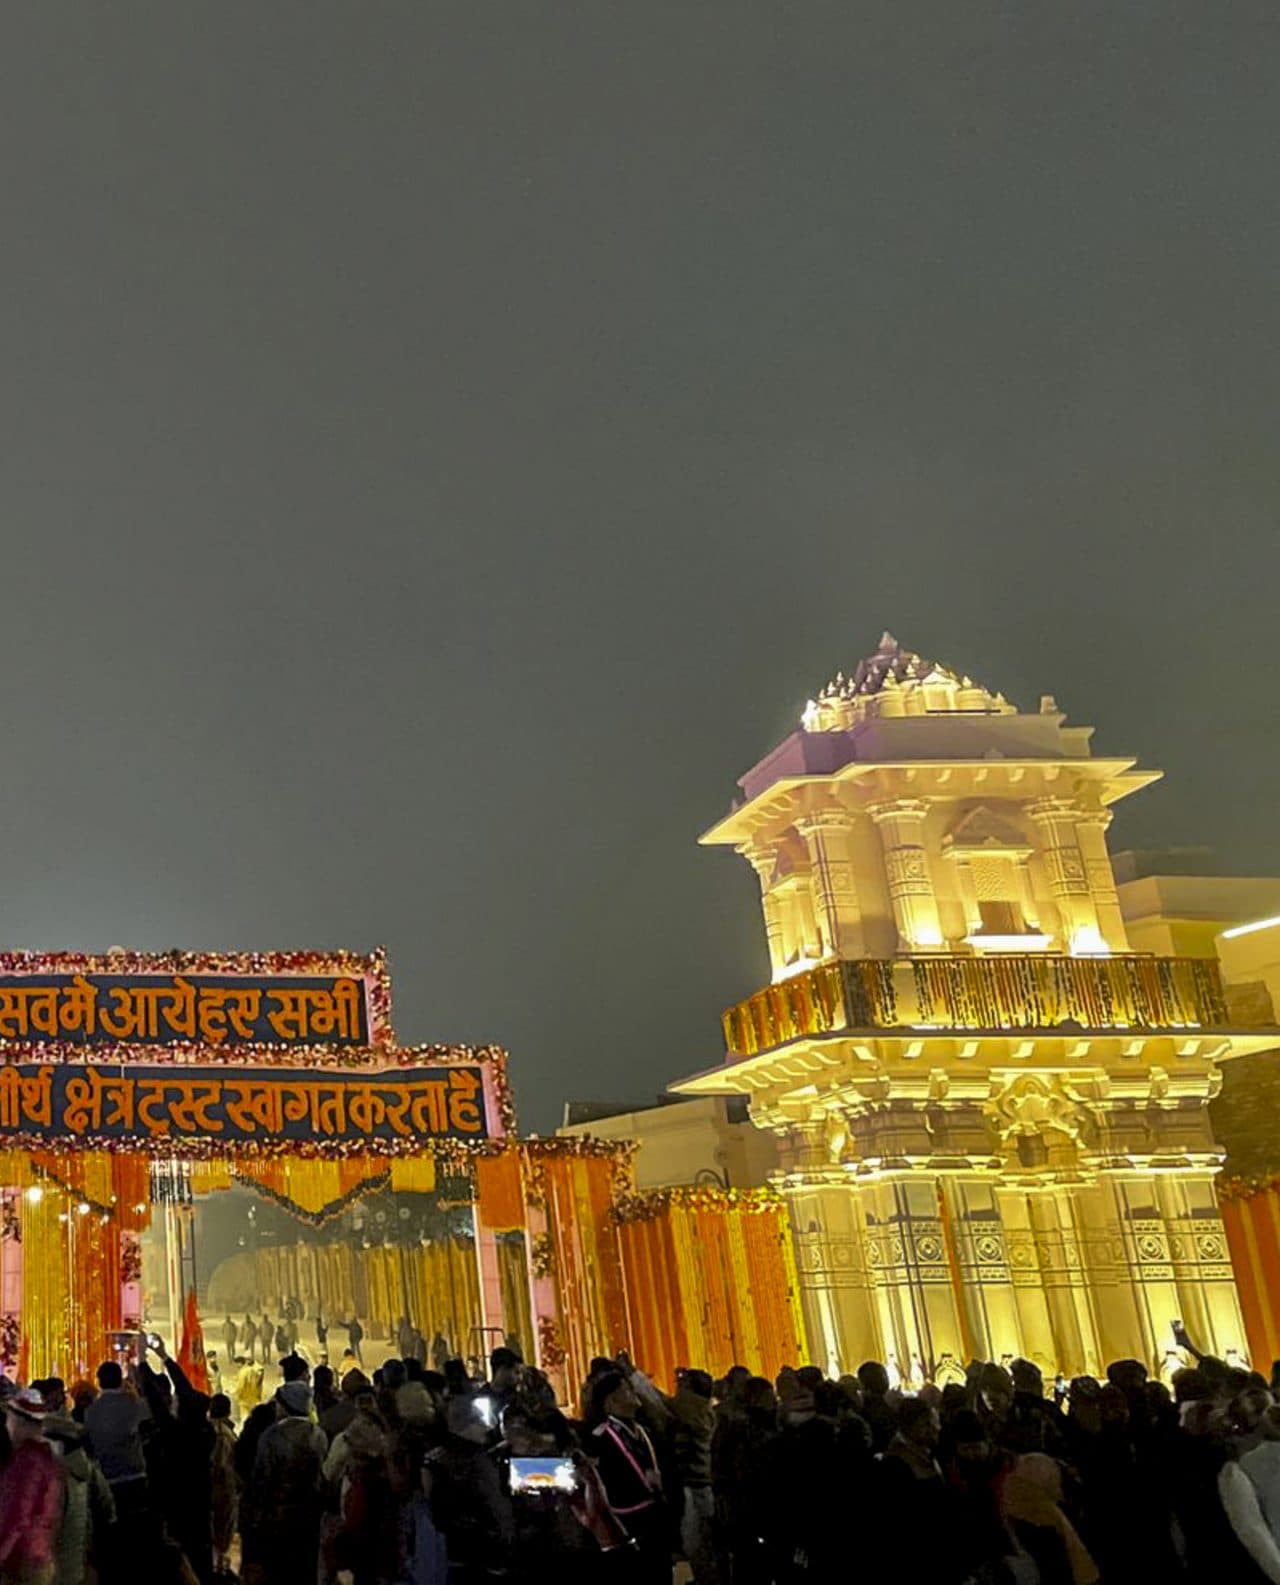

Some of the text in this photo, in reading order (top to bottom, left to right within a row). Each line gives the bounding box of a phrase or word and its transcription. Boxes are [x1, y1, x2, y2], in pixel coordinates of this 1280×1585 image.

[99, 976, 197, 1038] आये
[267, 977, 360, 1040] सभी
[64, 1066, 135, 1134] क्षेत्र
[224, 1081, 346, 1136] स्वागत
[448, 1070, 483, 1132] है
